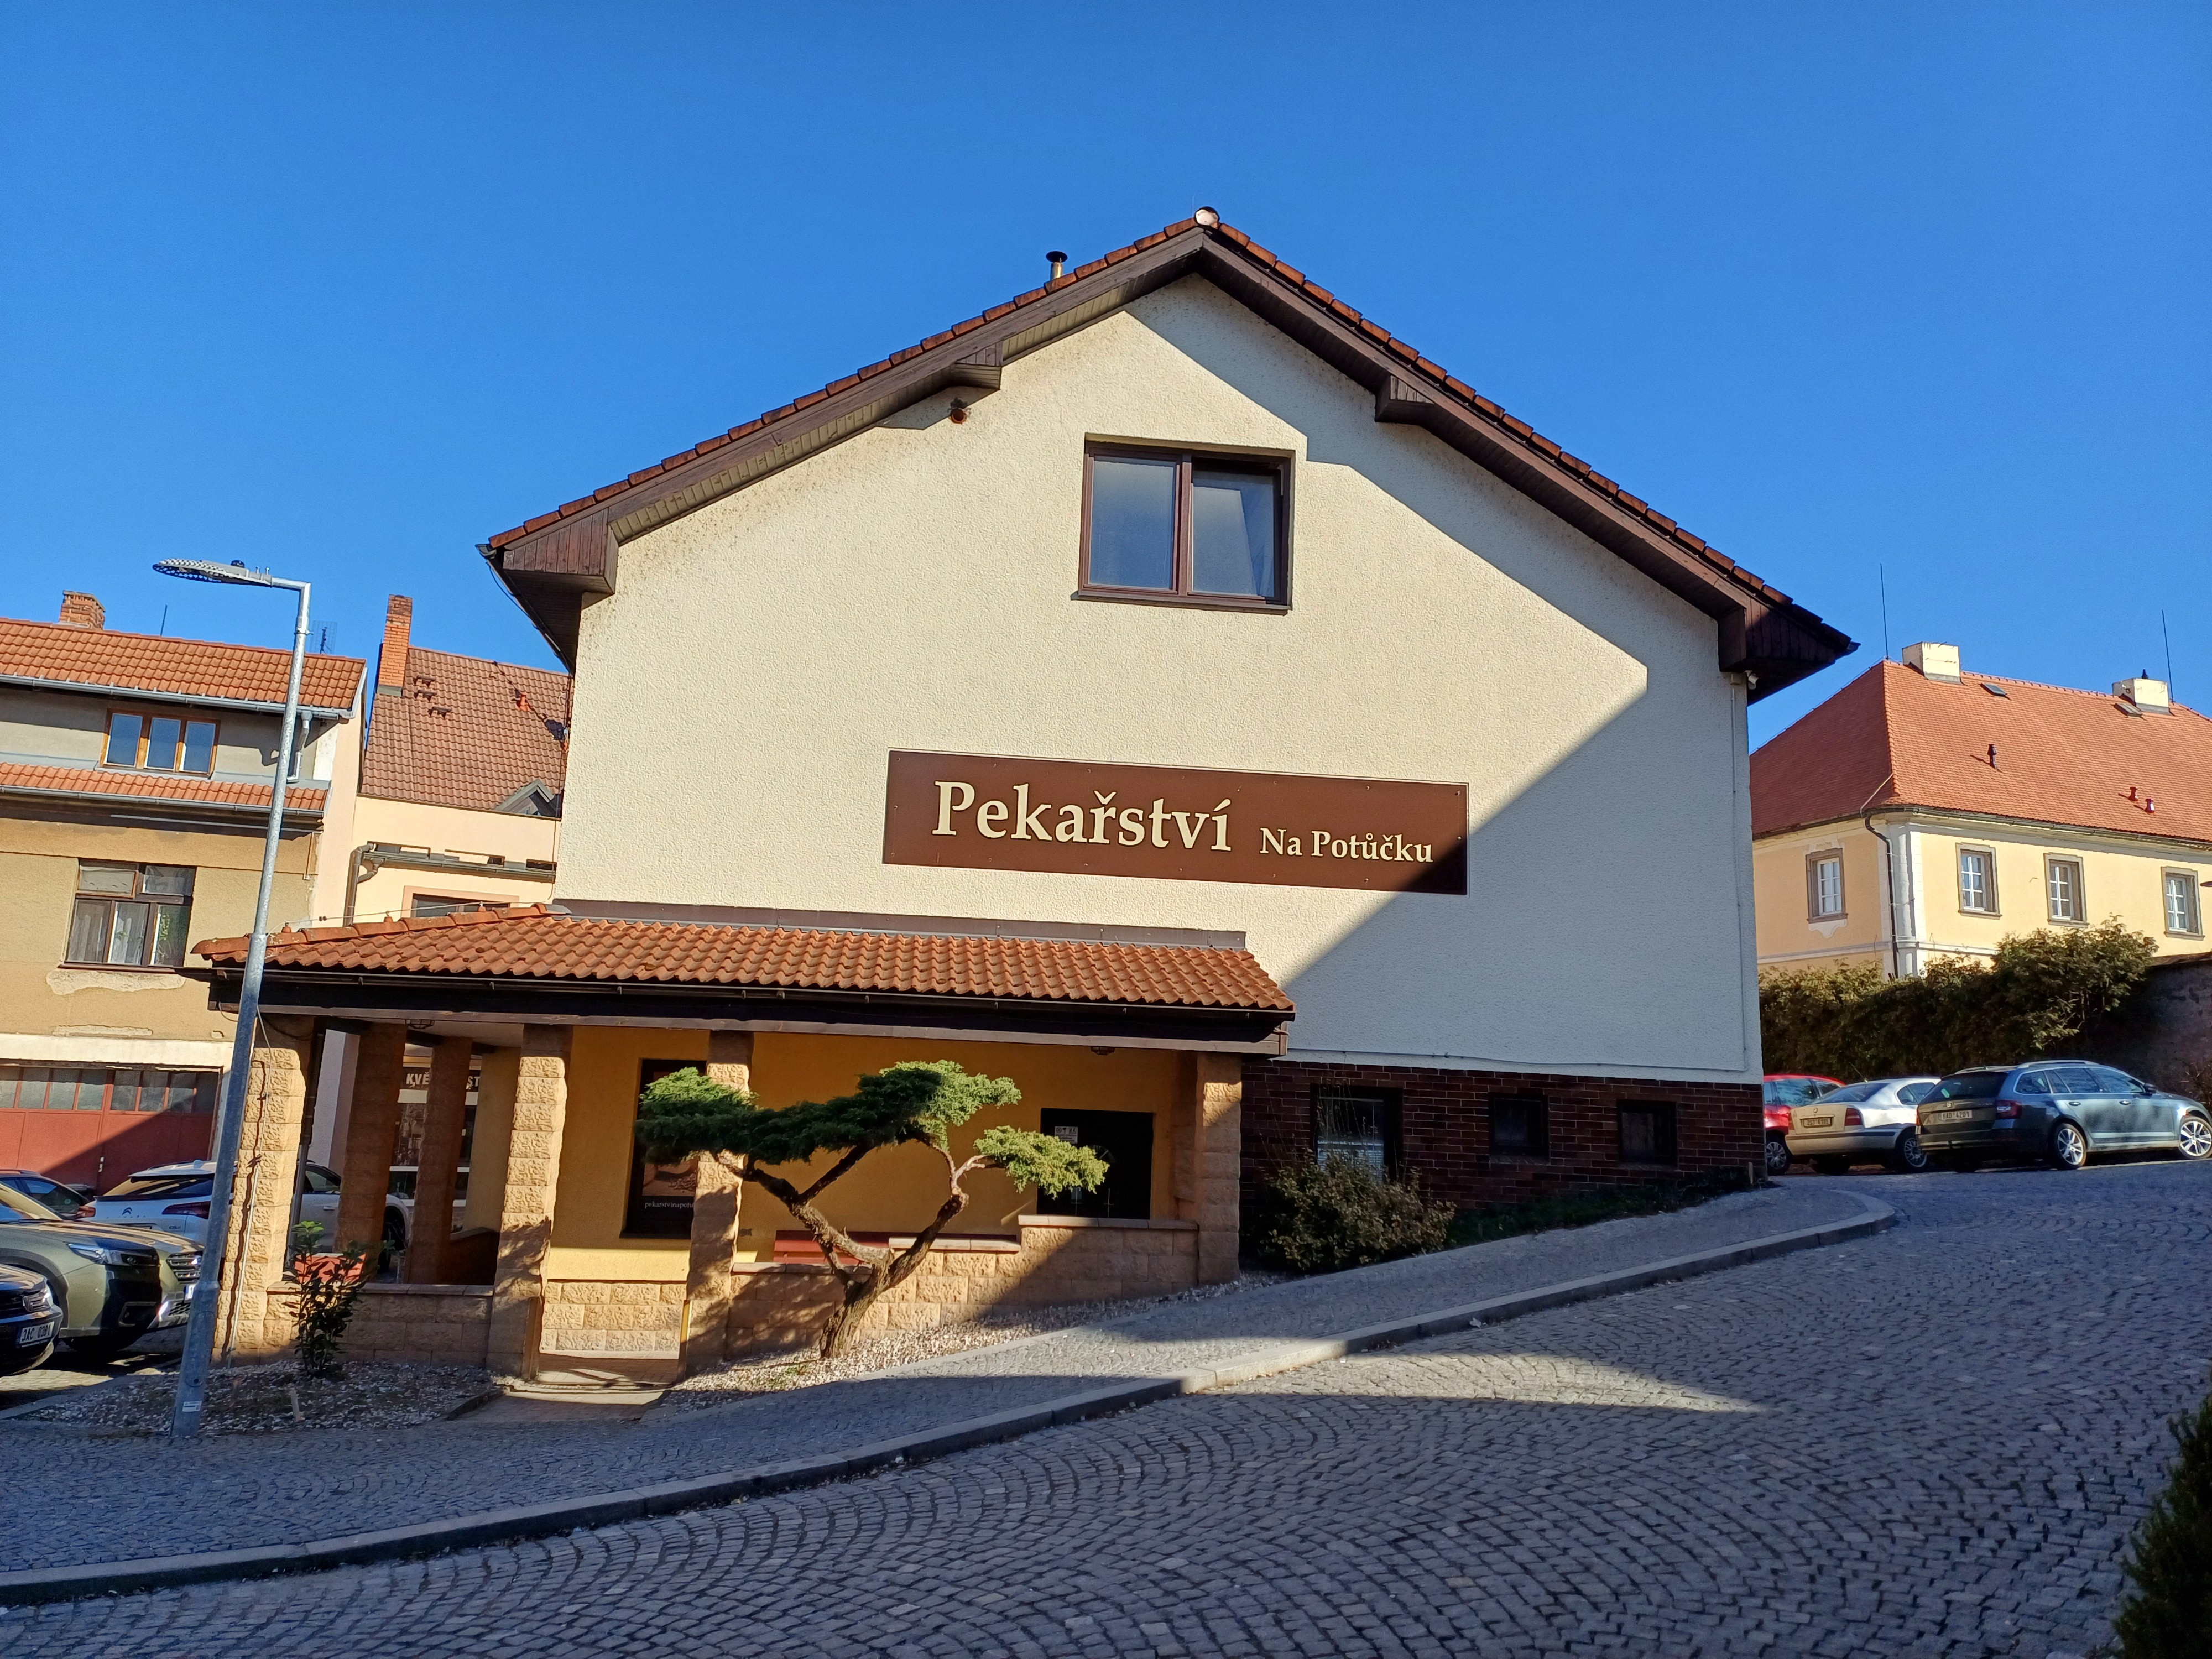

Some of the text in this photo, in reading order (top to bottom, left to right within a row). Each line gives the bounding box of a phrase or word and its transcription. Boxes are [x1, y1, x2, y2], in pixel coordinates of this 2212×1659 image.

[931, 781, 1433, 863] Pekařství Na Potůčku
[406, 1071, 430, 1085] KVĚ
[644, 1201, 694, 1209] pekarstvinapotu
